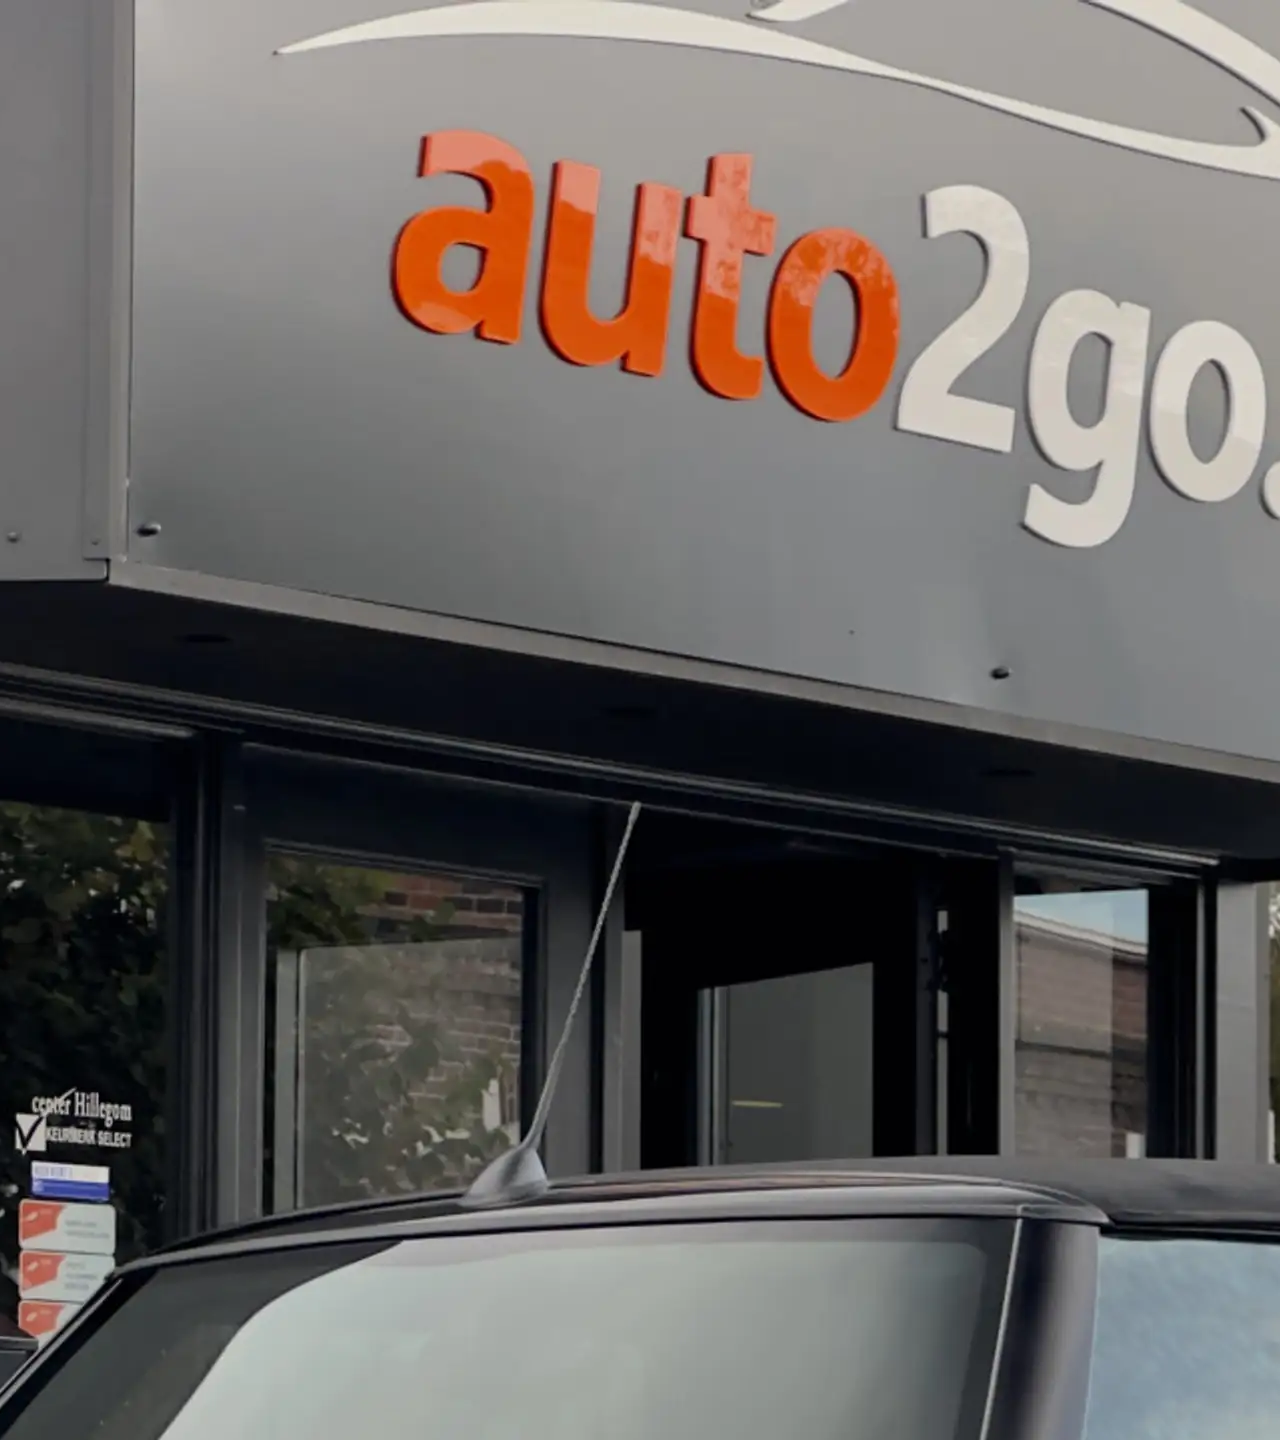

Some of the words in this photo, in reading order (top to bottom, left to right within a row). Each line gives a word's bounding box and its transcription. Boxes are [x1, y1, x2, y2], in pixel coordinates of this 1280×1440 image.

[32, 1096, 71, 1116] center
[74, 1091, 132, 1128] Hillegom
[98, 1130, 132, 1148] SELECT
